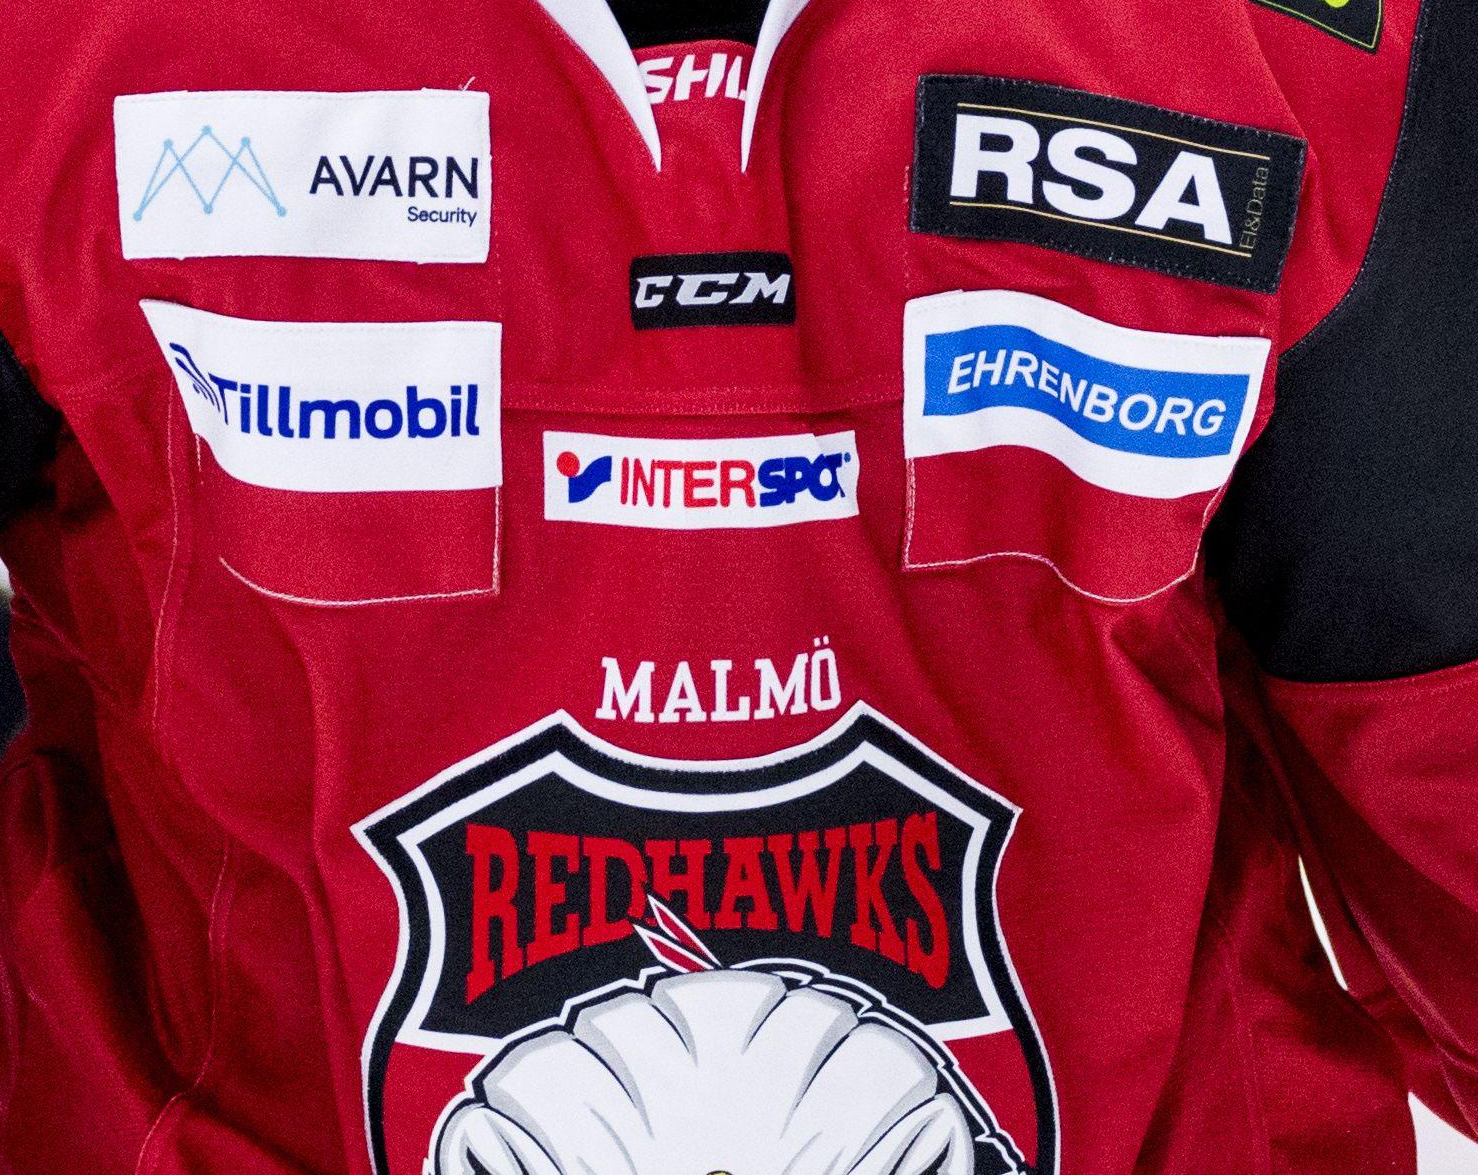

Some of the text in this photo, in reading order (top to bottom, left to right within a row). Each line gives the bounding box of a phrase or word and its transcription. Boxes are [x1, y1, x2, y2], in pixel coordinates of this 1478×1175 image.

[309, 155, 479, 199] AVARN
[408, 206, 478, 227] Security
[950, 113, 1233, 245] RSA
[634, 272, 791, 309] CCM
[207, 370, 480, 440] Tillmobil
[948, 349, 1226, 437] EHRENBORG
[596, 635, 842, 725] MALMÖ
[465, 812, 950, 1006] REDHAWKS
